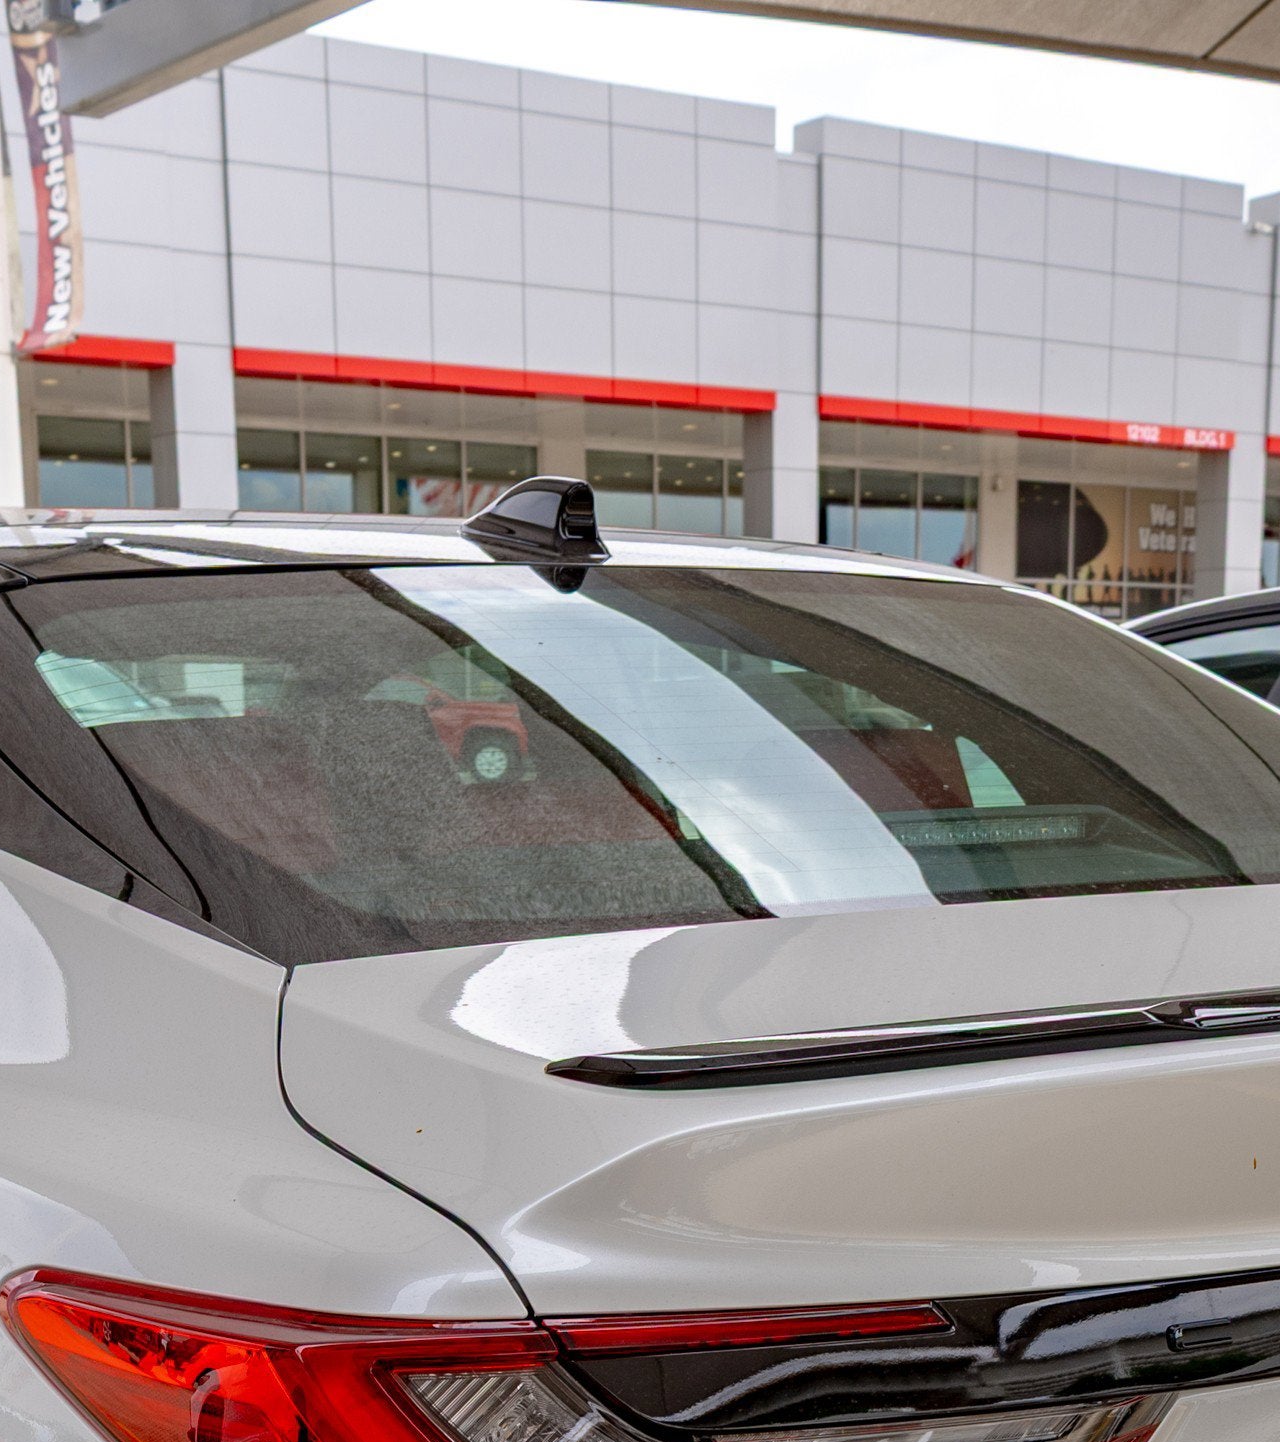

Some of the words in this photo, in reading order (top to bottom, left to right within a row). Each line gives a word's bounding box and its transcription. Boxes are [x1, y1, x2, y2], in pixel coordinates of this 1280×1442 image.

[36, 62, 68, 238] Vehicles
[43, 246, 72, 333] New
[1138, 525, 1196, 552] Vetera
